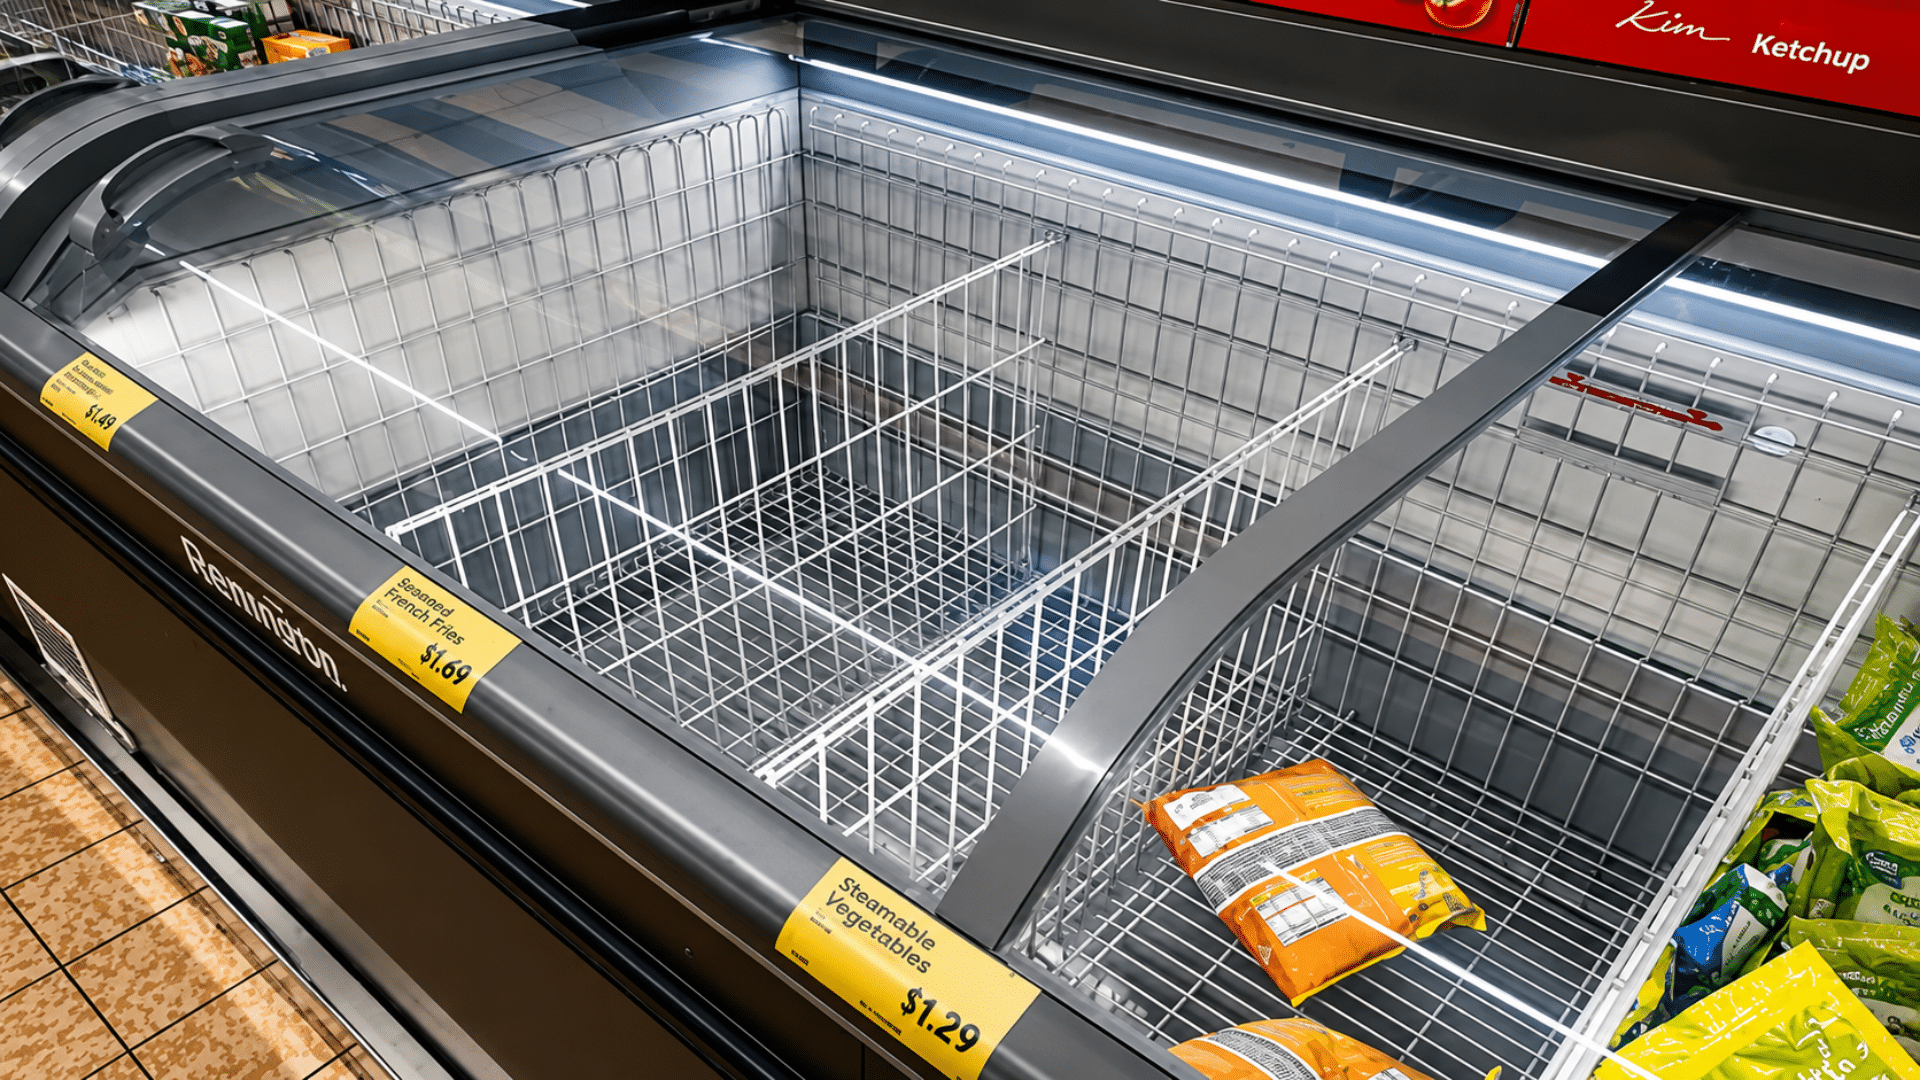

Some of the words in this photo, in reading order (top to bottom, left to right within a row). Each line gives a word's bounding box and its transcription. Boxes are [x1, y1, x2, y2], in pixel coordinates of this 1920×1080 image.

[1615, 0, 1730, 42] Kim
[1751, 33, 1870, 75] Ketchup
[85, 403, 117, 430] $1.49
[384, 587, 430, 623] French
[429, 617, 465, 646] Fries
[420, 642, 472, 685] $1.69
[825, 890, 932, 974] Vegetables
[838, 877, 936, 951] Steamable
[901, 987, 981, 1053] $1.29
